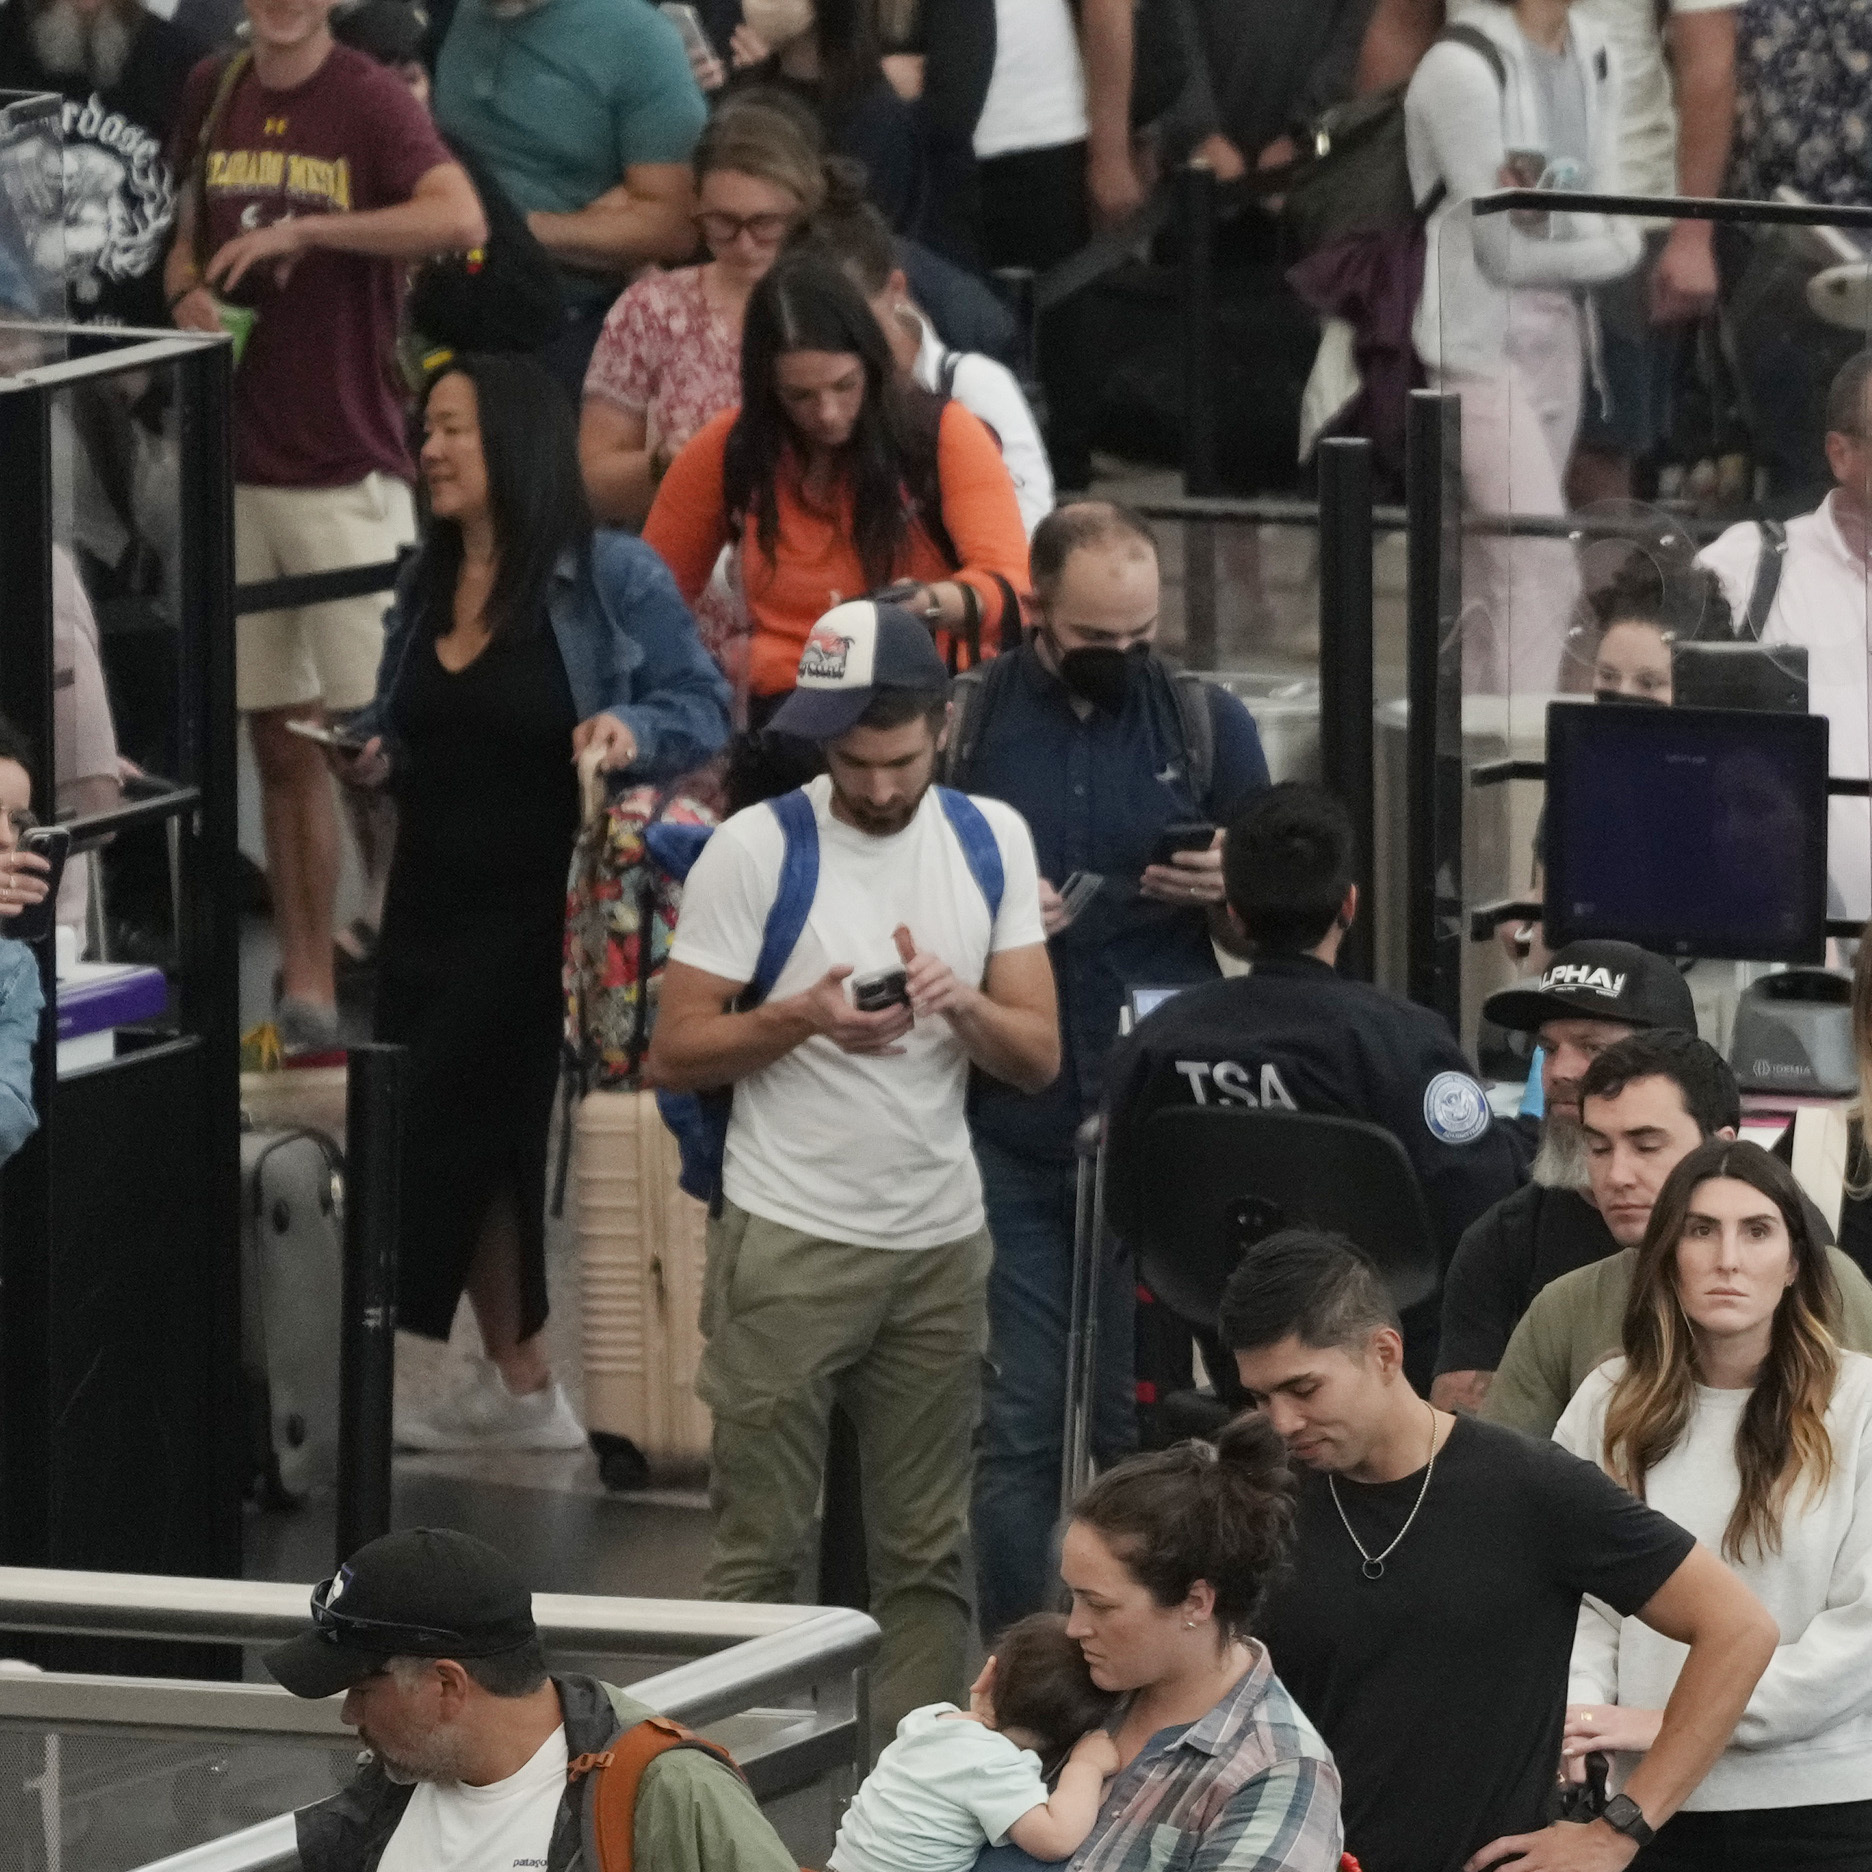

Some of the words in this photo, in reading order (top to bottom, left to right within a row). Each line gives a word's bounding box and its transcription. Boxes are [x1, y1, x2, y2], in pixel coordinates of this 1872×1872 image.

[1540, 964, 1613, 991] LPHA
[1174, 1059, 1298, 1112] TSA
[512, 1858, 549, 1868] patago
